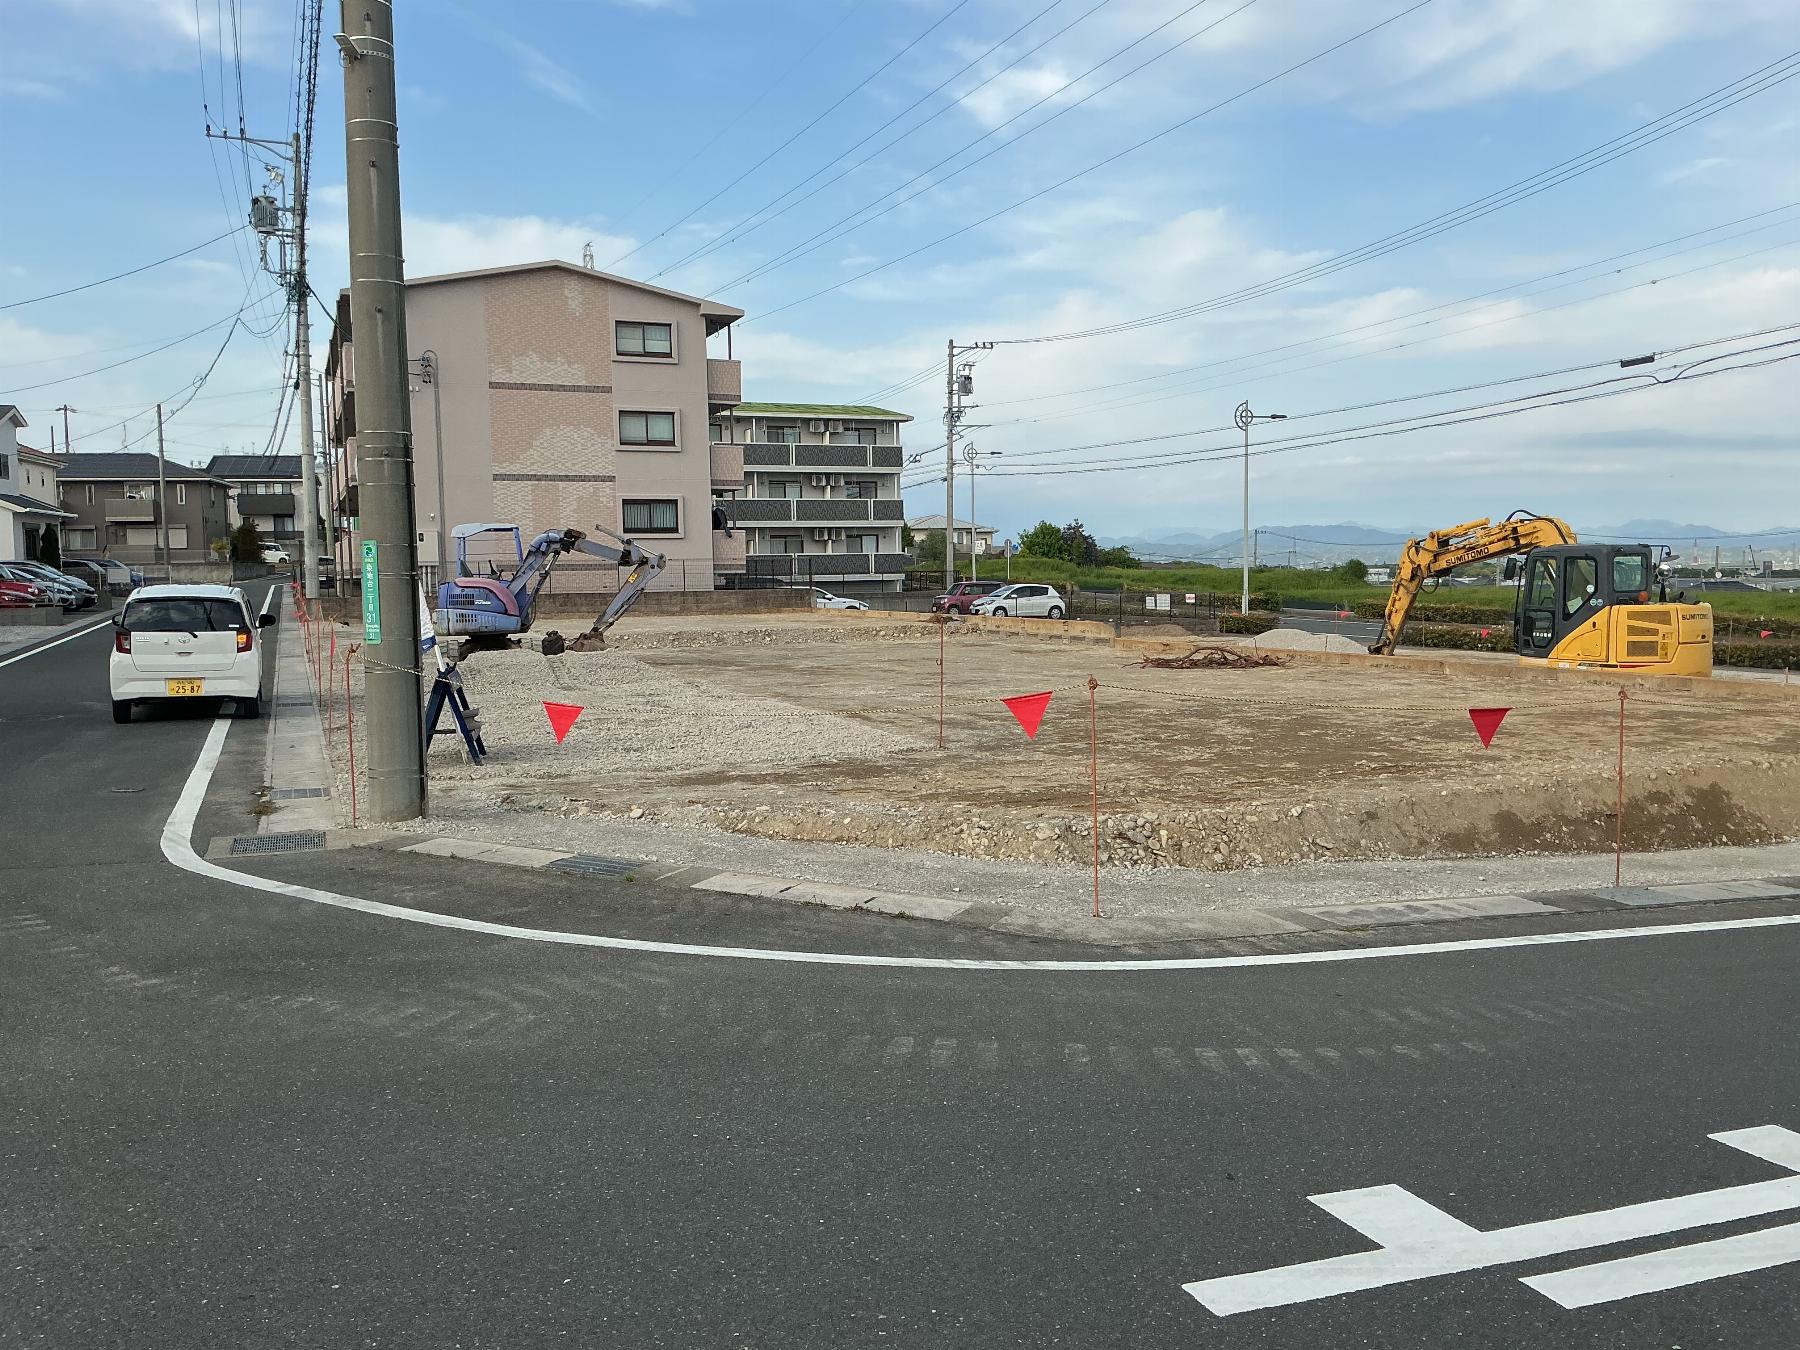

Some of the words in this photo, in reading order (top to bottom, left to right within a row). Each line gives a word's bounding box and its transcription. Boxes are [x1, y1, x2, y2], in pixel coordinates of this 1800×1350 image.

[1445, 547, 1489, 566] SUMITOMO
[367, 612, 376, 623] 31
[176, 685, 200, 694] 25-87
